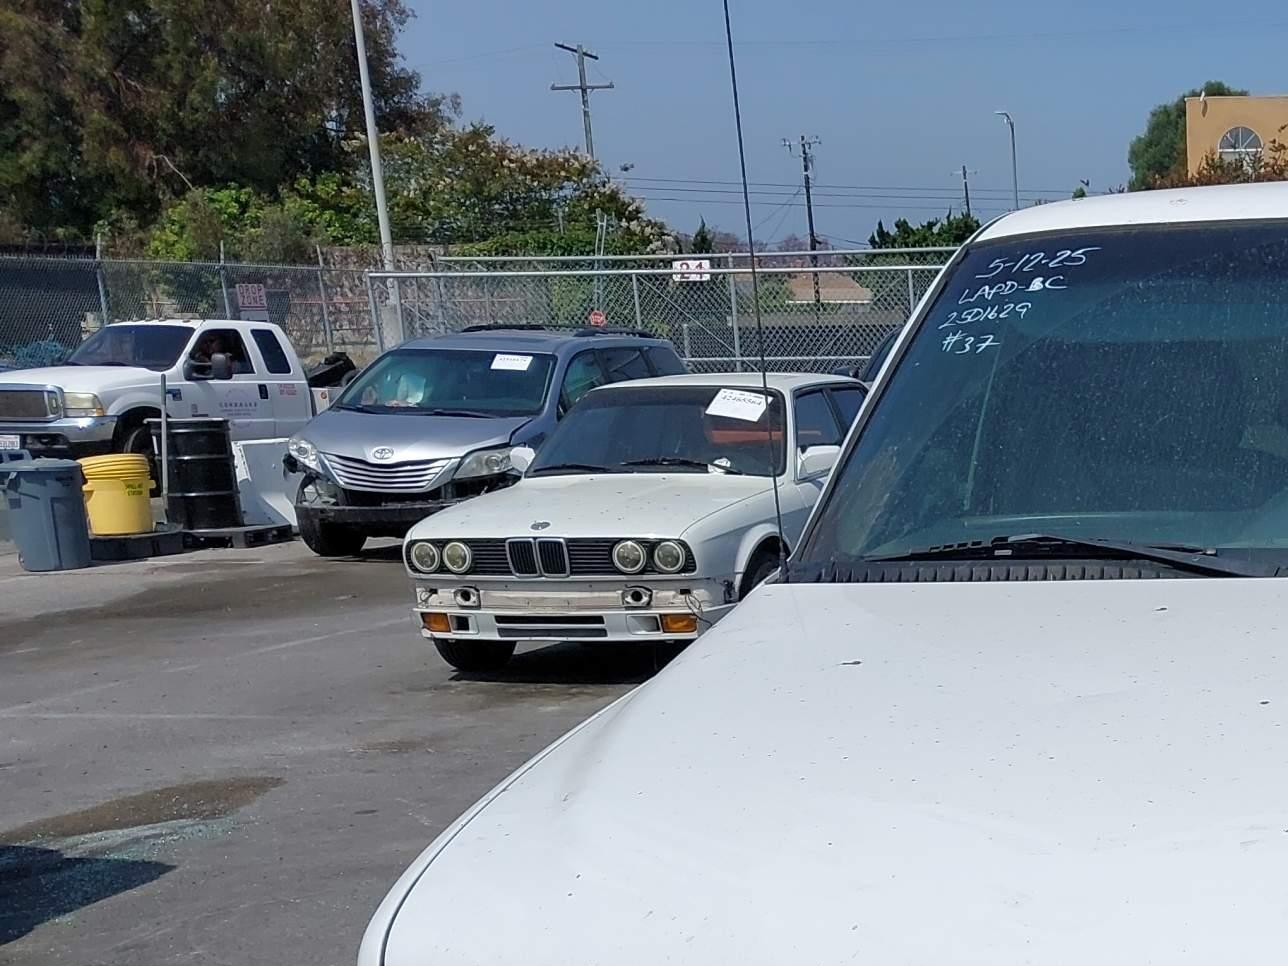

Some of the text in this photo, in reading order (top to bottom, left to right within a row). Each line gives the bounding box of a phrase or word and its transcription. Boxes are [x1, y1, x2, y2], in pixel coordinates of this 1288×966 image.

[975, 246, 1102, 278] 5-12-25
[239, 284, 263, 295] DROP
[241, 294, 265, 305] ZONE
[941, 330, 1000, 354] #37
